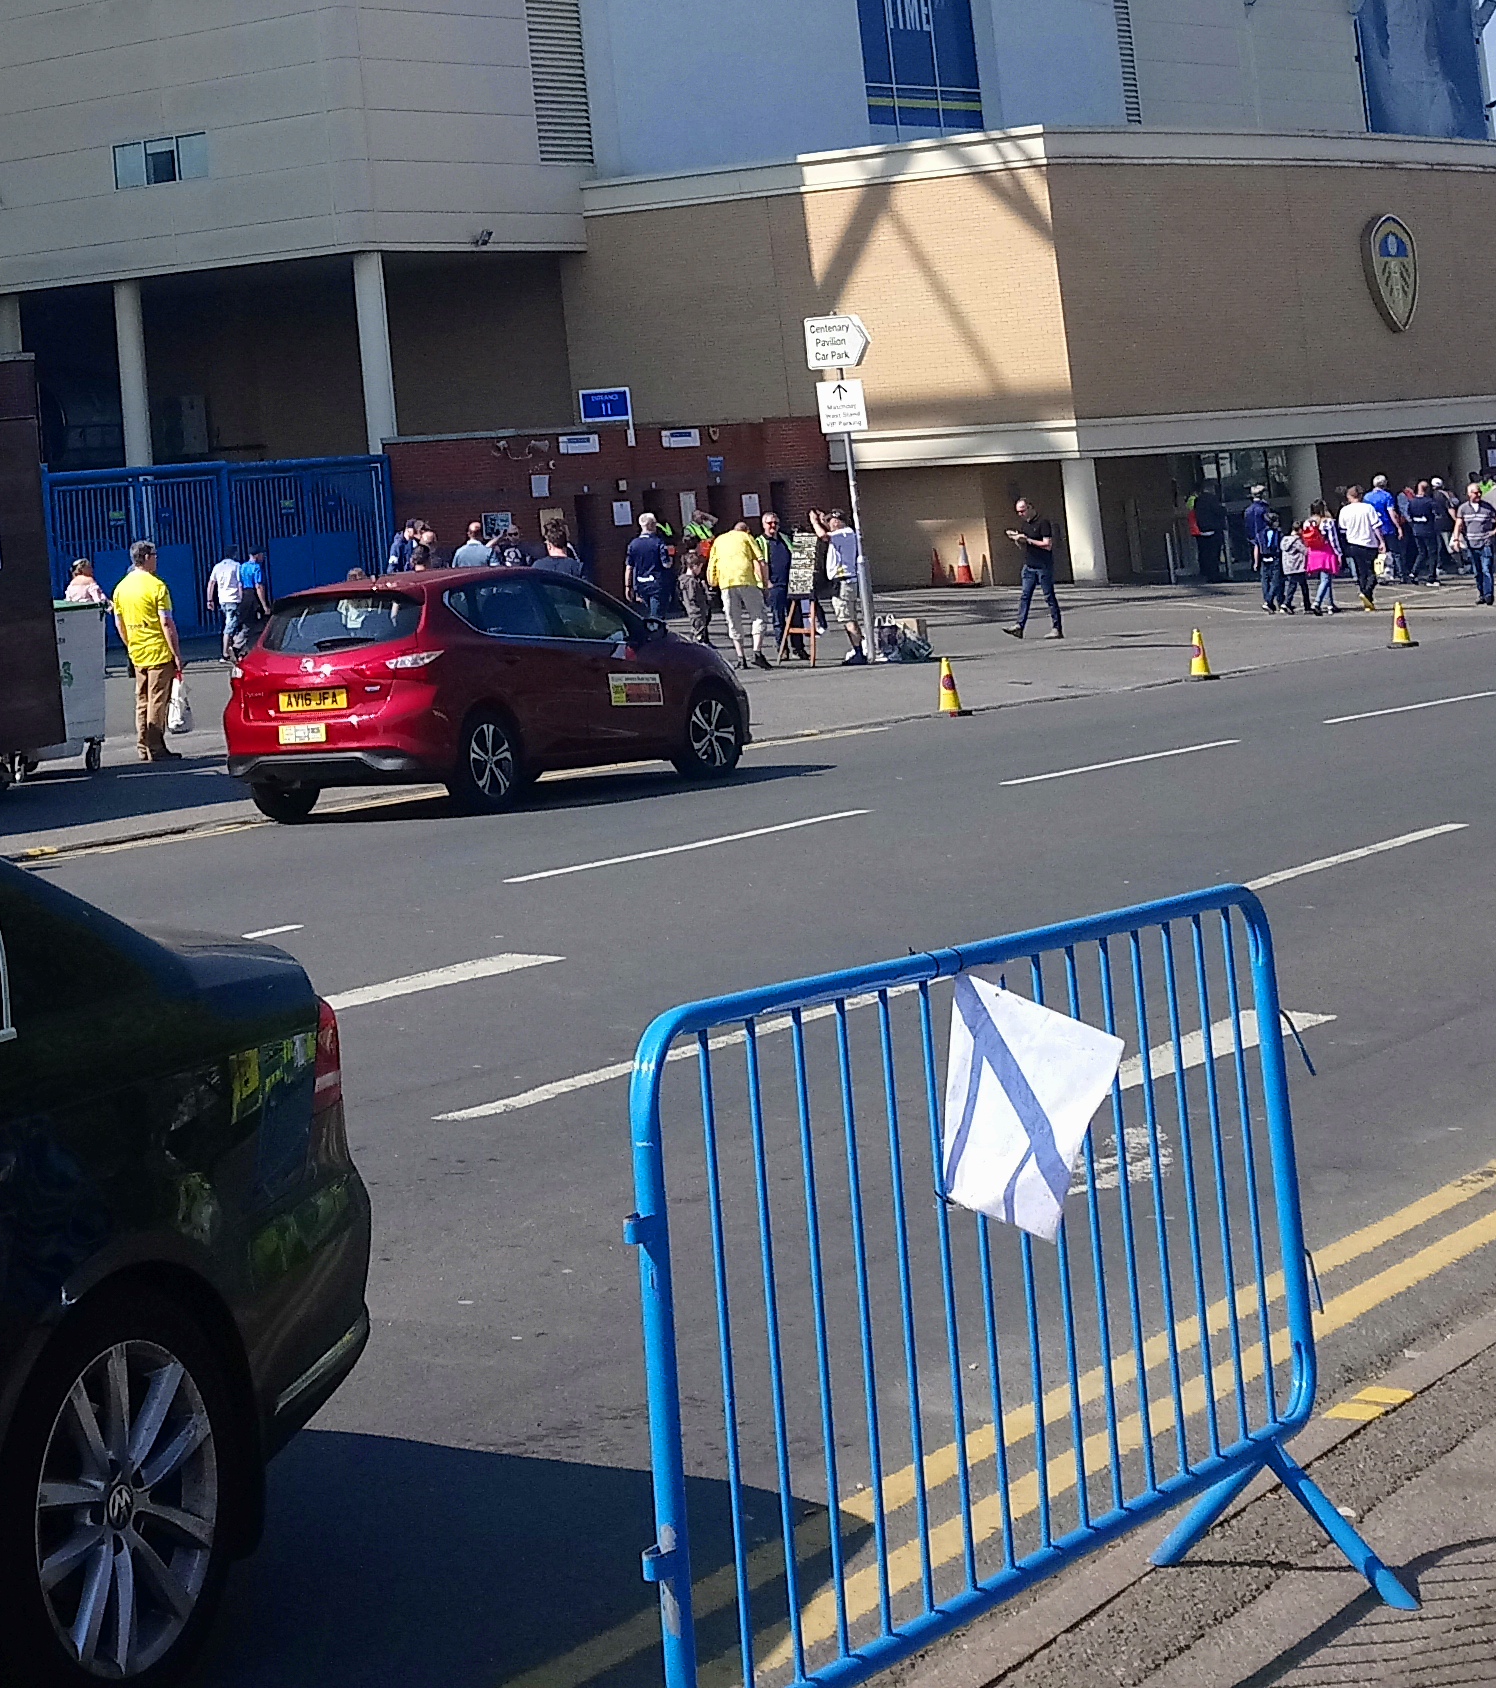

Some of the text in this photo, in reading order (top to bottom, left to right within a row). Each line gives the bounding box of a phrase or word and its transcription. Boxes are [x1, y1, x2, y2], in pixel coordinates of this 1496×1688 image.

[810, 324, 849, 334] Centenary
[815, 337, 846, 347] Pavilion
[815, 351, 850, 361] Car Park
[286, 690, 339, 707] AV16 JFA
